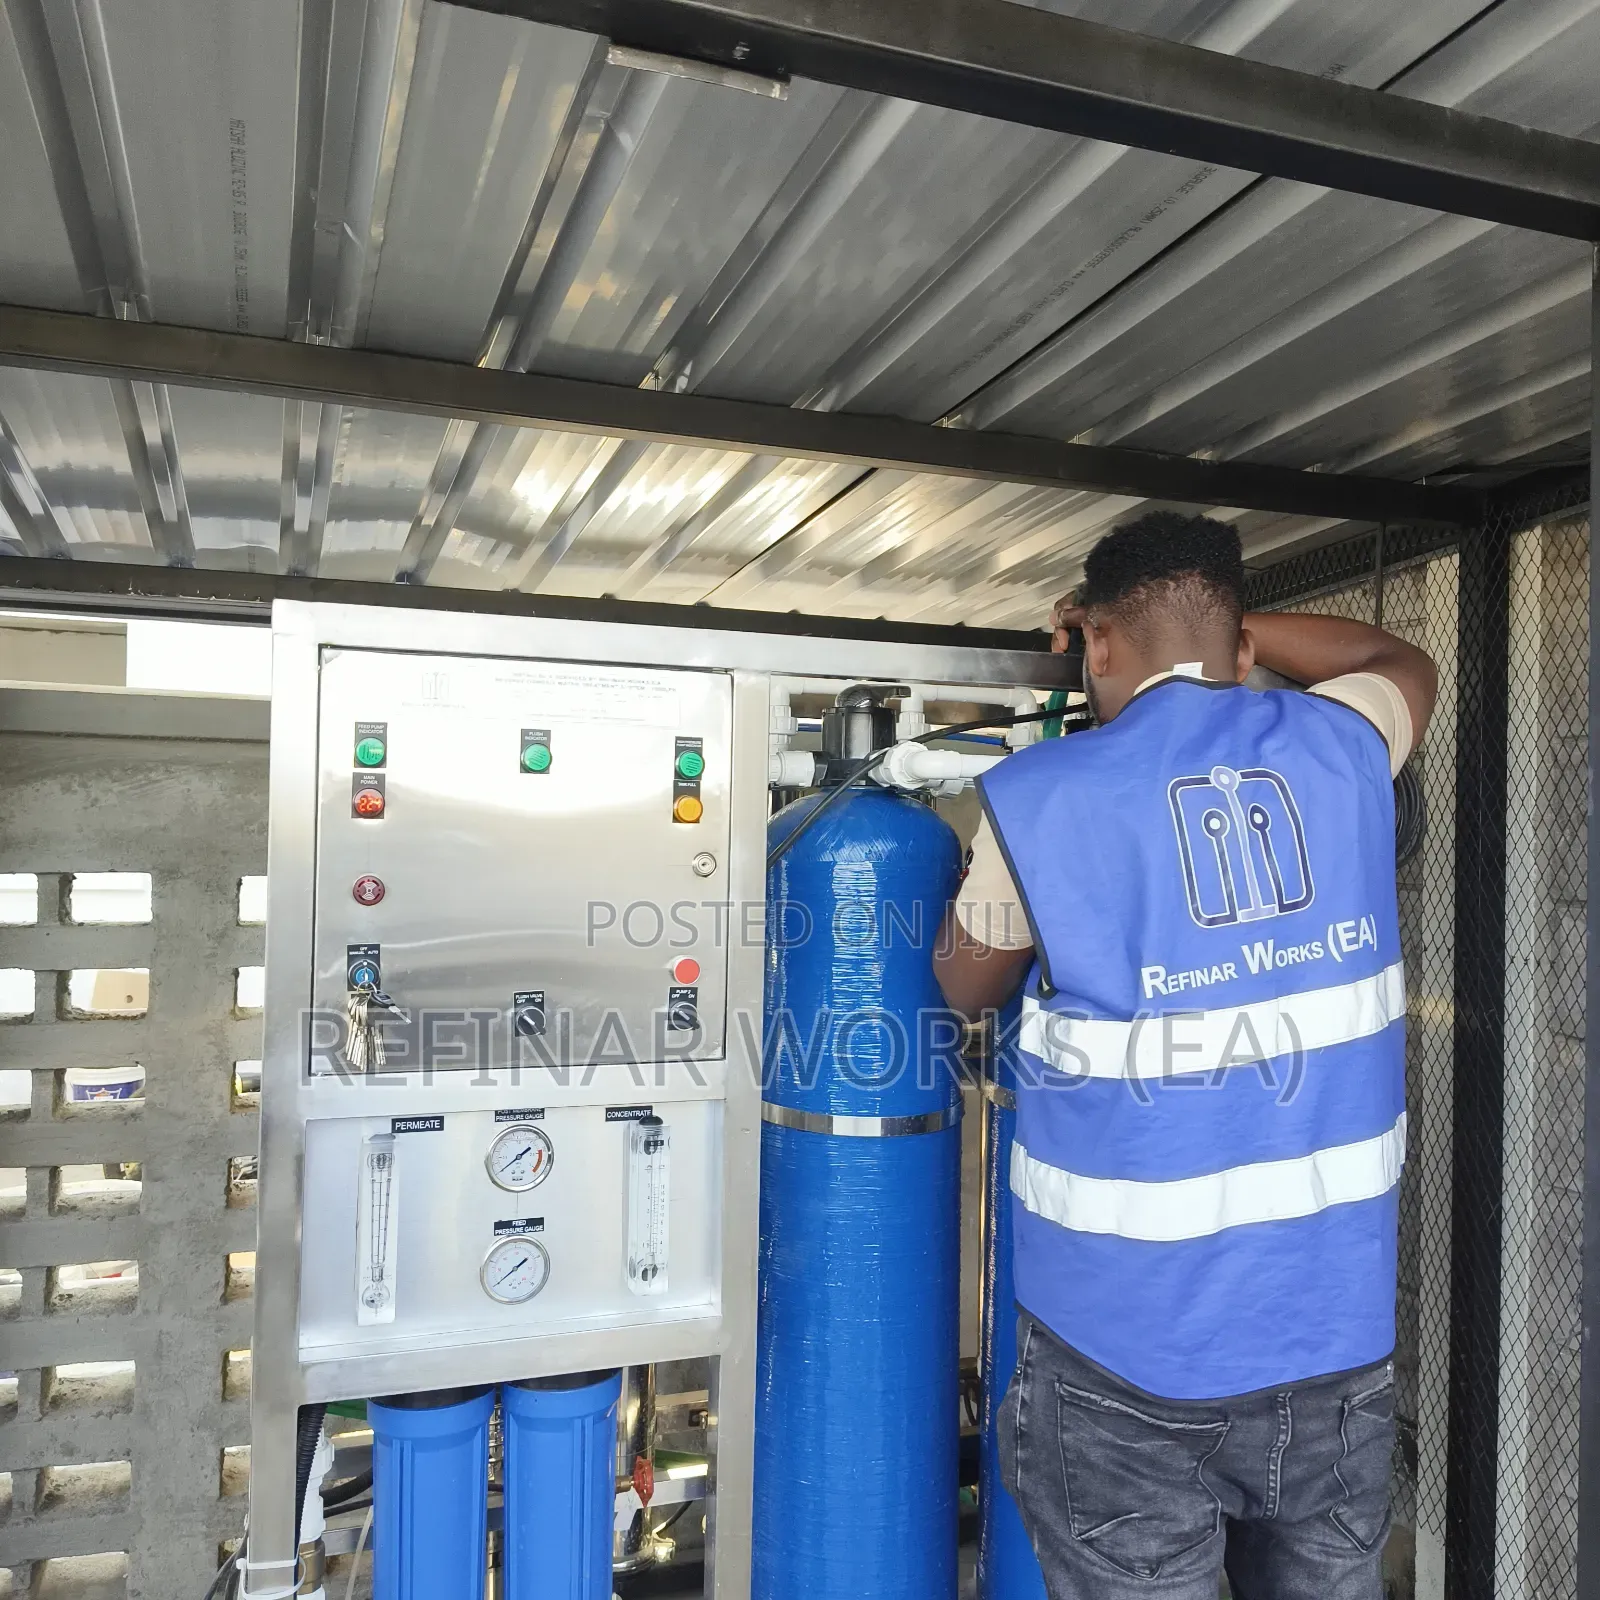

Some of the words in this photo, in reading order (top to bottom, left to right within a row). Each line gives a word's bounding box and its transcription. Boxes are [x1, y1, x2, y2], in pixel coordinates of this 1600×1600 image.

[1327, 914, 1377, 962] (EA)
[395, 1120, 440, 1130] PERMEATE
[495, 1227, 524, 1235] PRESSURE
